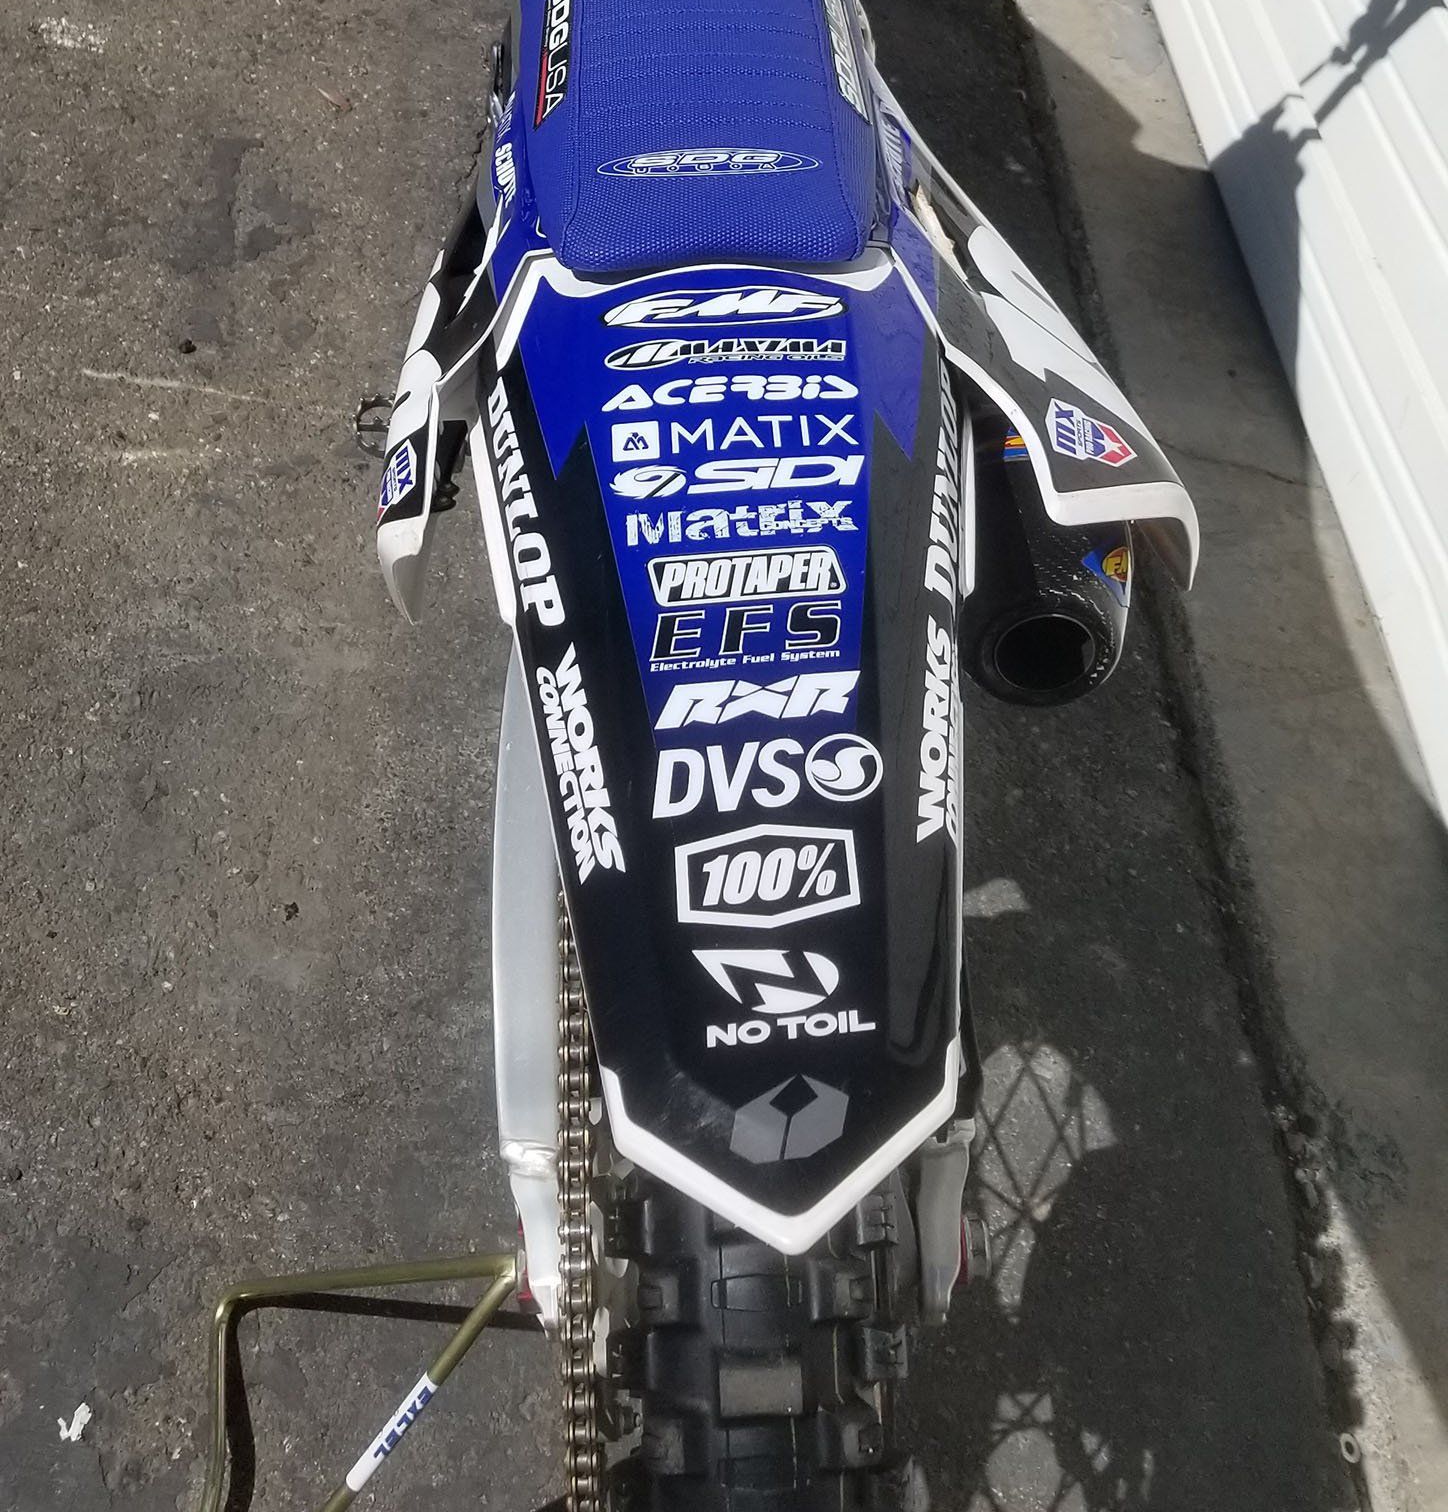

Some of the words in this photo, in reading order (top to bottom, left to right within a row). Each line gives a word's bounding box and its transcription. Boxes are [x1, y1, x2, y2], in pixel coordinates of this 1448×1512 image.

[605, 289, 841, 327] FMF
[601, 374, 859, 413] ACERBIS
[669, 413, 860, 455] MATIX
[487, 375, 567, 627] DUNLOP
[686, 454, 866, 496] SIDI
[659, 551, 832, 602] PROTAPER
[650, 656, 737, 673] Electrolyte
[742, 652, 775, 665] Fuel
[780, 649, 841, 663] System
[654, 670, 861, 730] RXR
[915, 614, 952, 845] WORKS
[535, 665, 598, 886] CONNECTION
[554, 641, 627, 874] WORKS
[652, 737, 805, 819] DVS
[702, 842, 837, 907] 100%
[706, 1019, 772, 1048] NO
[777, 1009, 876, 1039] TOIL
[373, 1385, 434, 1459] EXCEL
